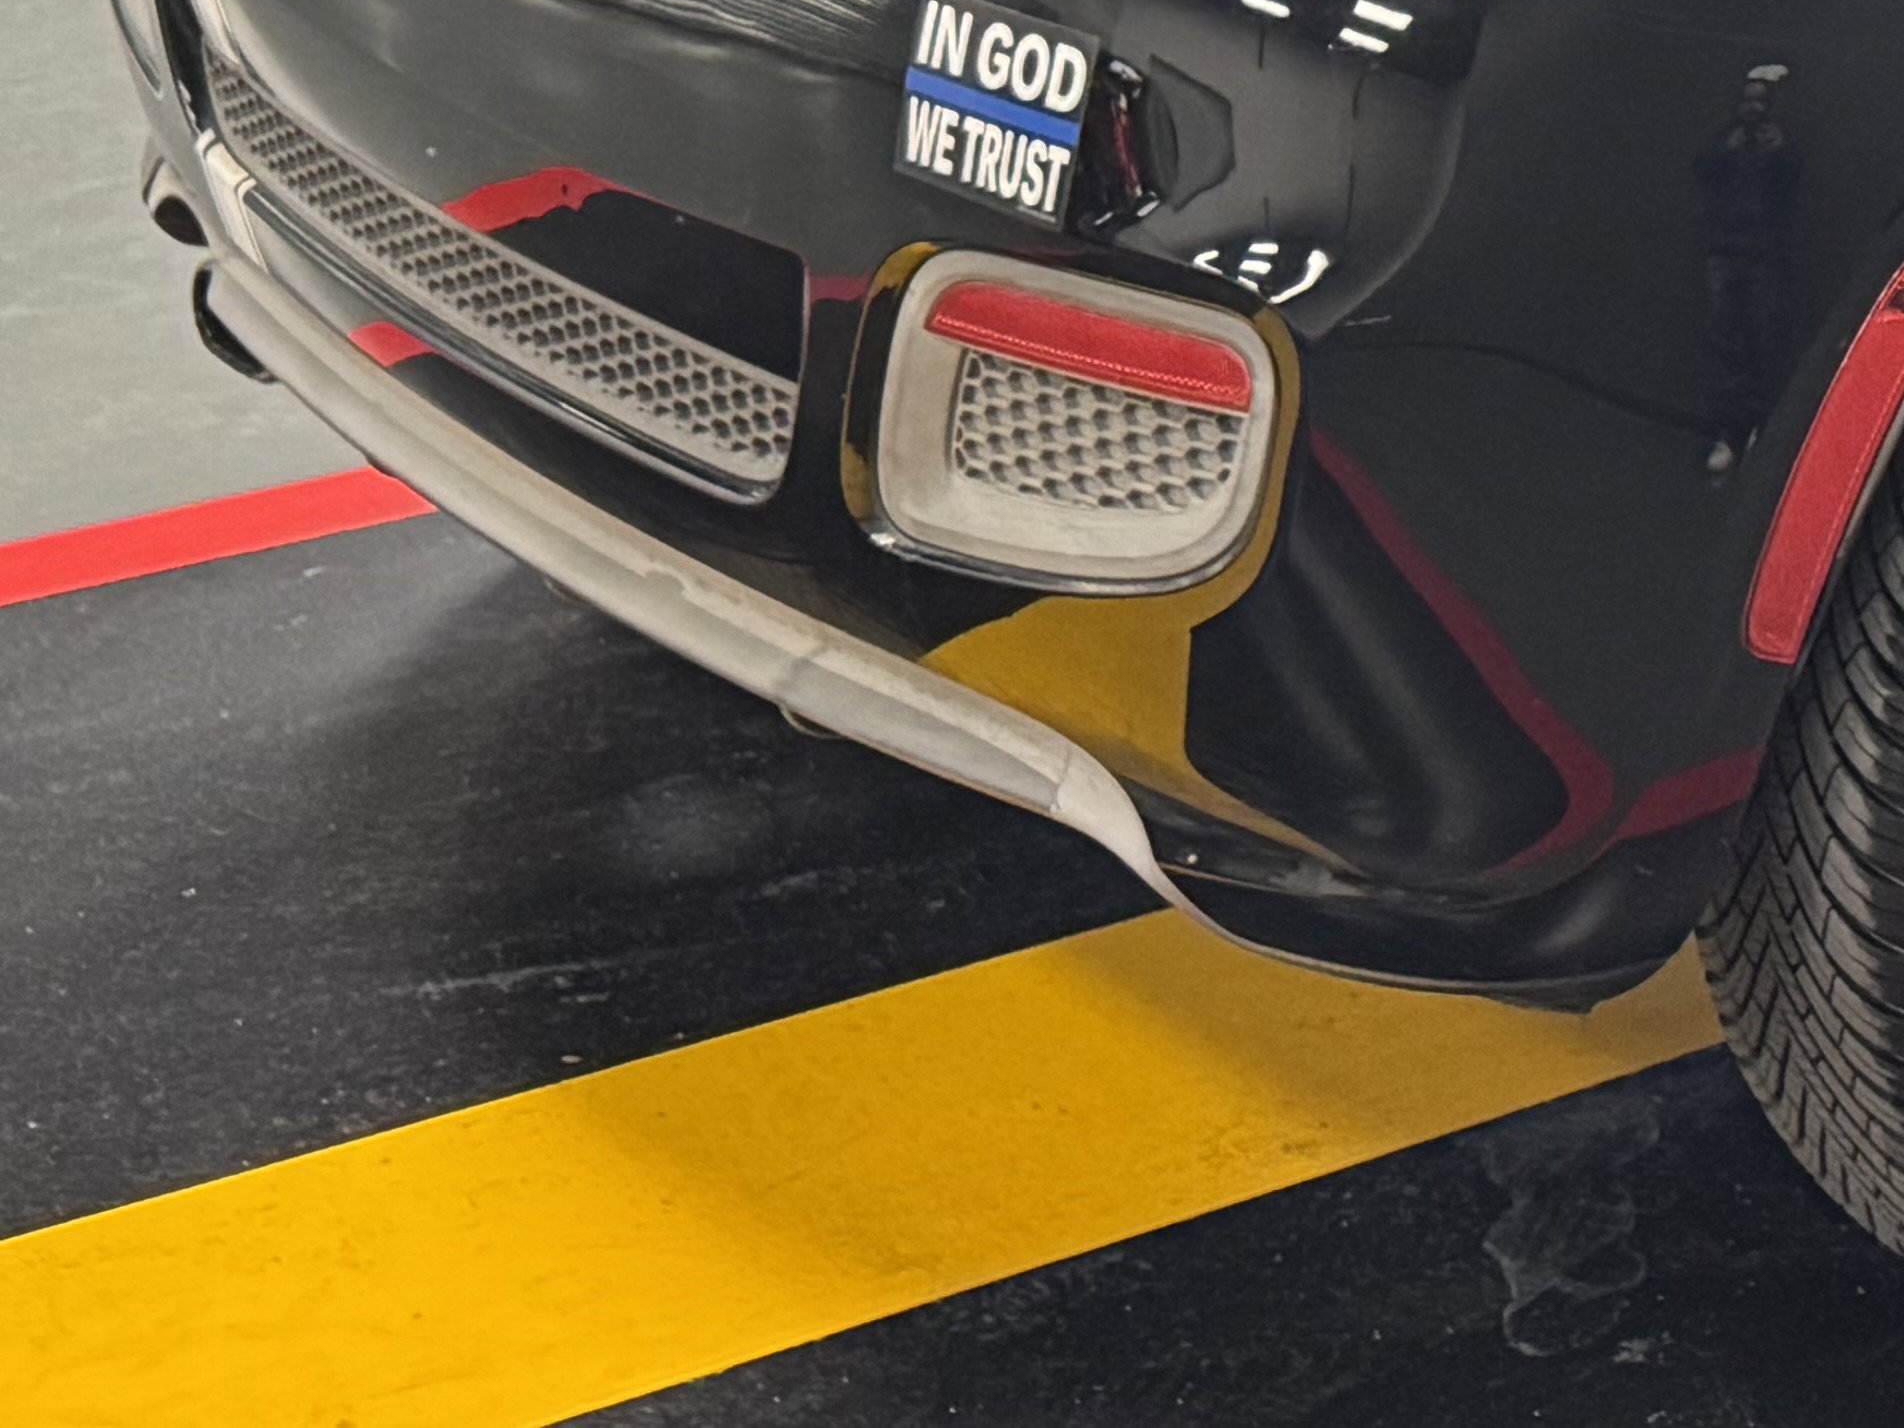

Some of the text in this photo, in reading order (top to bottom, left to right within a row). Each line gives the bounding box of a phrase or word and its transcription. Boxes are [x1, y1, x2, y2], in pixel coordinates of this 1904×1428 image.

[917, 0, 1087, 112] IN GOD
[906, 96, 1070, 212] WE TRUST
